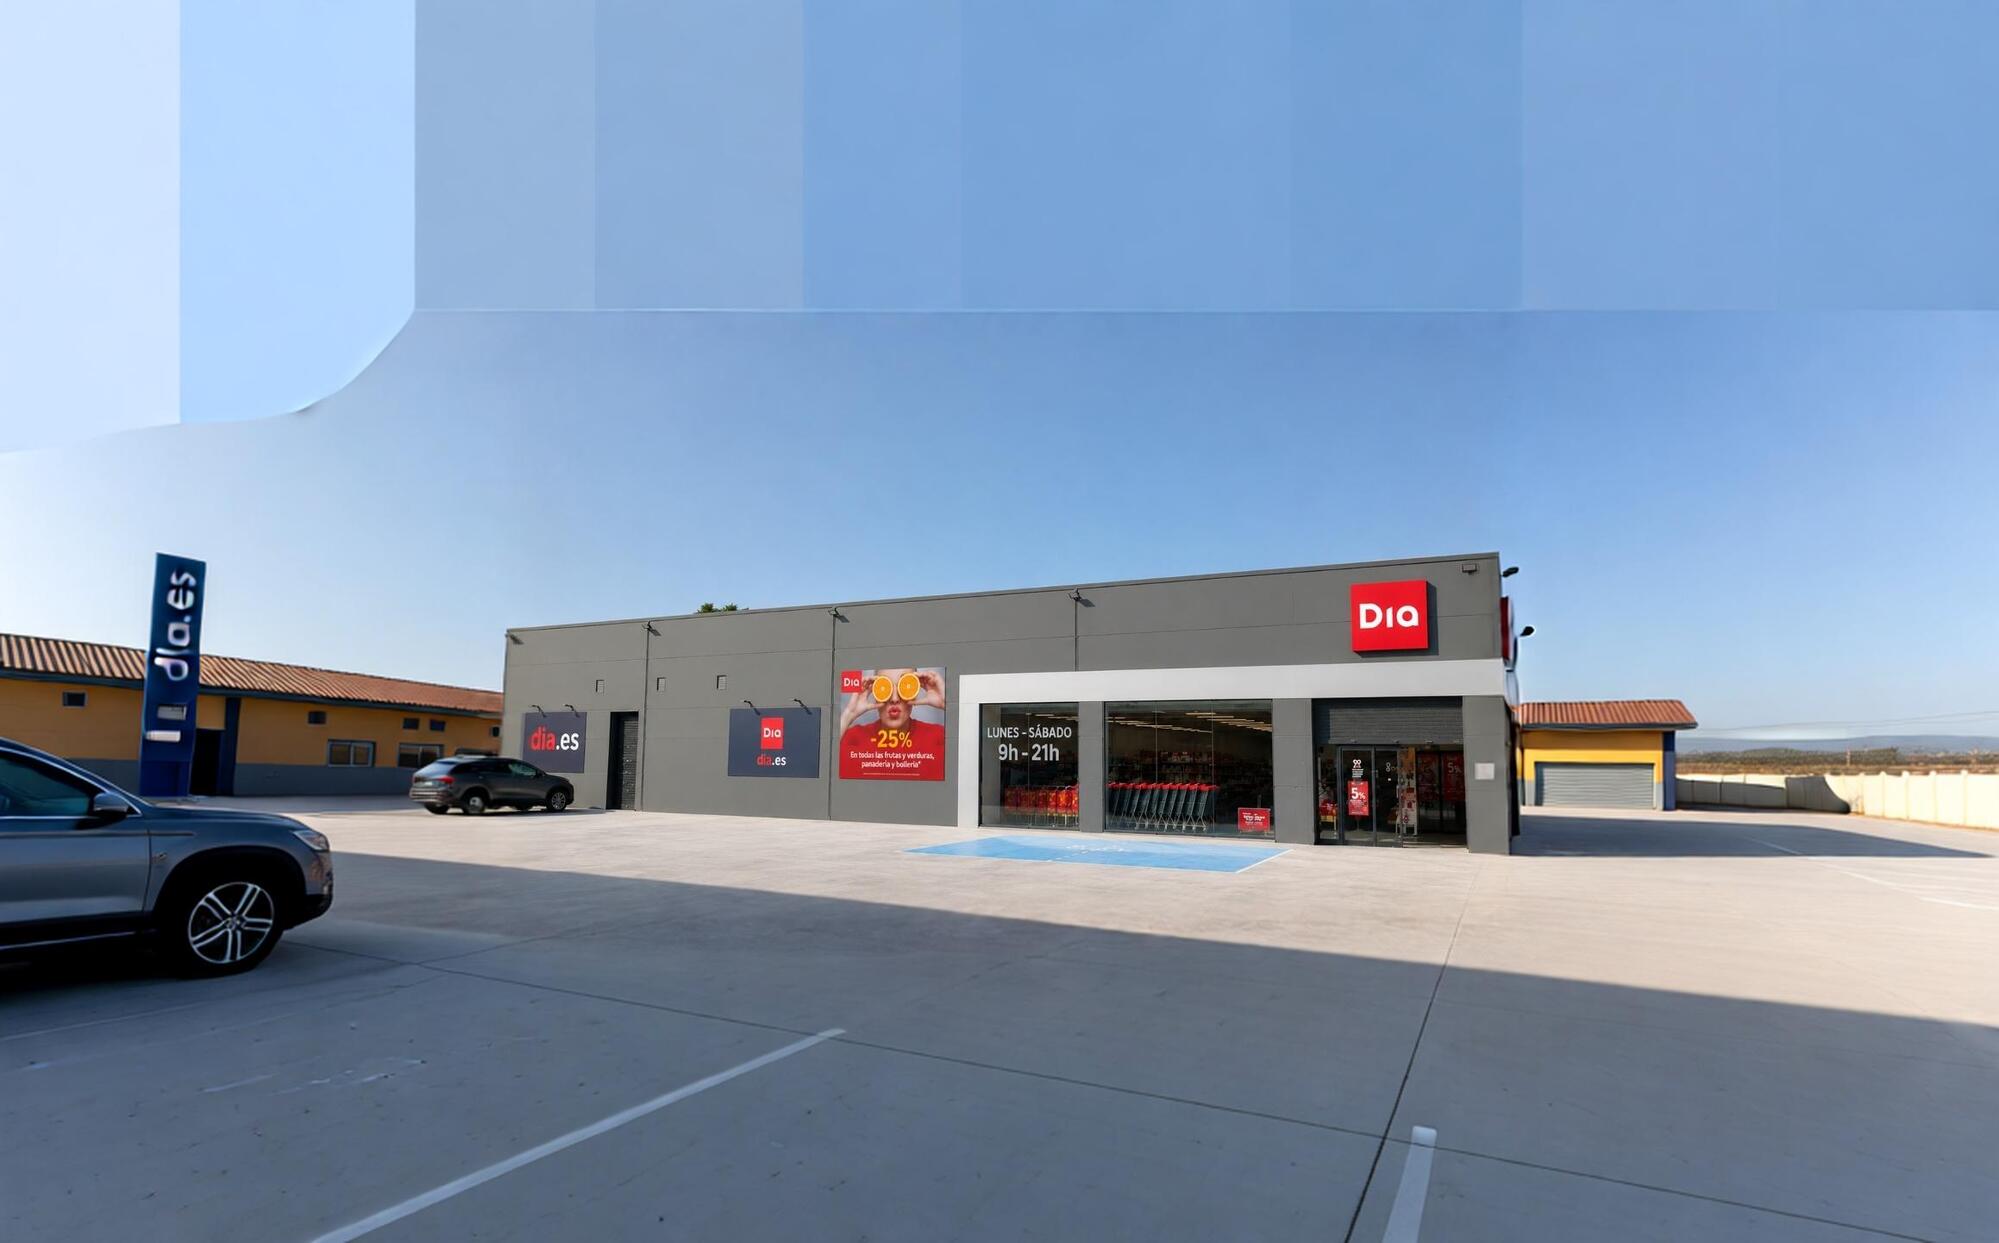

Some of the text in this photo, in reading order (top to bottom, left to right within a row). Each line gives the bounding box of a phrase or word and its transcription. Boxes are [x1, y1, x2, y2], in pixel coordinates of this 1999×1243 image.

[987, 727, 1019, 738] LUNES
[1028, 724, 1072, 738] SÁBADO
[530, 726, 579, 751] dia.es
[870, 729, 913, 748] -25%
[858, 751, 874, 759] todas
[875, 751, 884, 759] las
[884, 751, 901, 759] frutas
[907, 751, 935, 760] verduras,
[998, 743, 1018, 761] 9h
[1031, 743, 1060, 761] 21h
[756, 754, 787, 766] dia.es
[1351, 787, 1366, 800] 5%
